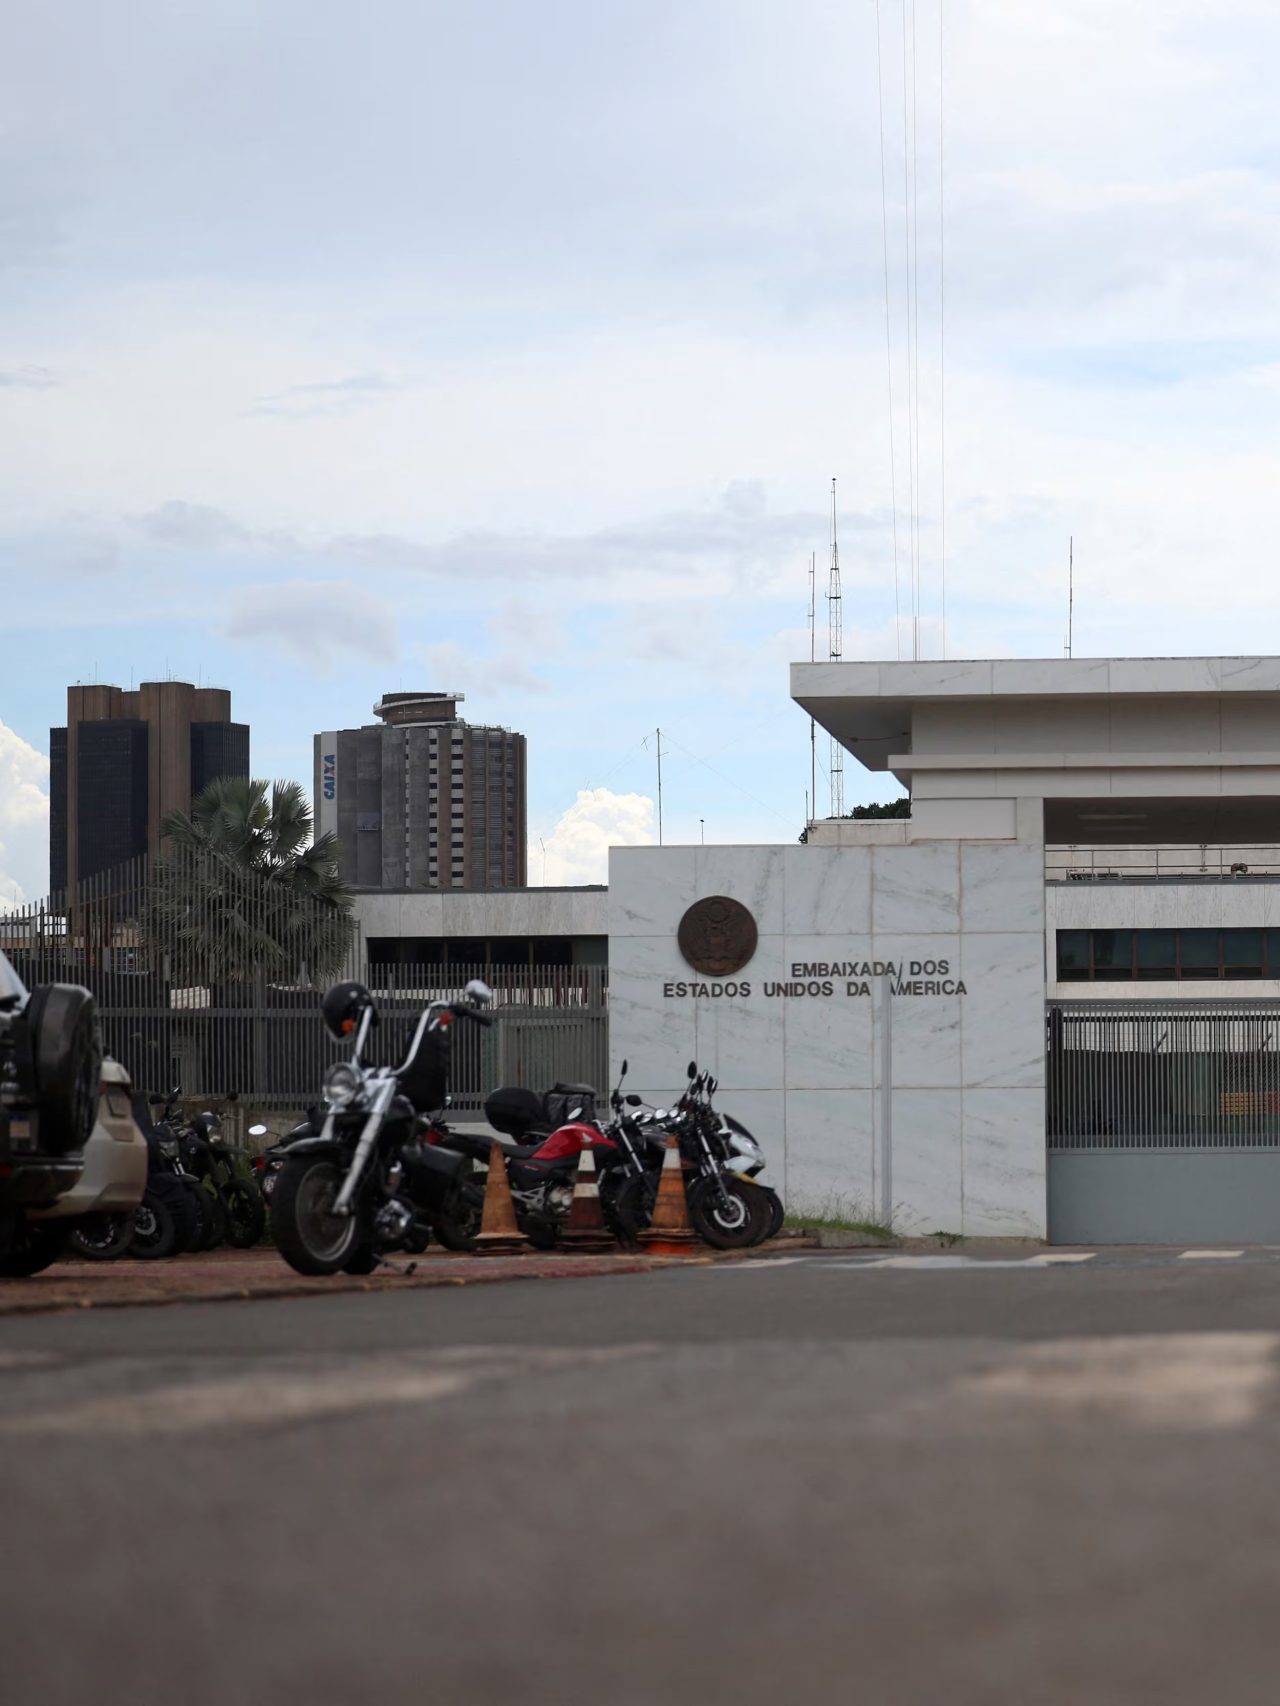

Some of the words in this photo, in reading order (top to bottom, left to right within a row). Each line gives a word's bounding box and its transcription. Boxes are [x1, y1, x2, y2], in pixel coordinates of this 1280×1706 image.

[324, 754, 335, 800] CAIXA
[791, 962, 896, 977] EMBAIXADA
[909, 959, 949, 976] DOS
[663, 981, 751, 998] ESTADOS
[763, 981, 834, 997] UNIDOS
[846, 981, 871, 997] DA
